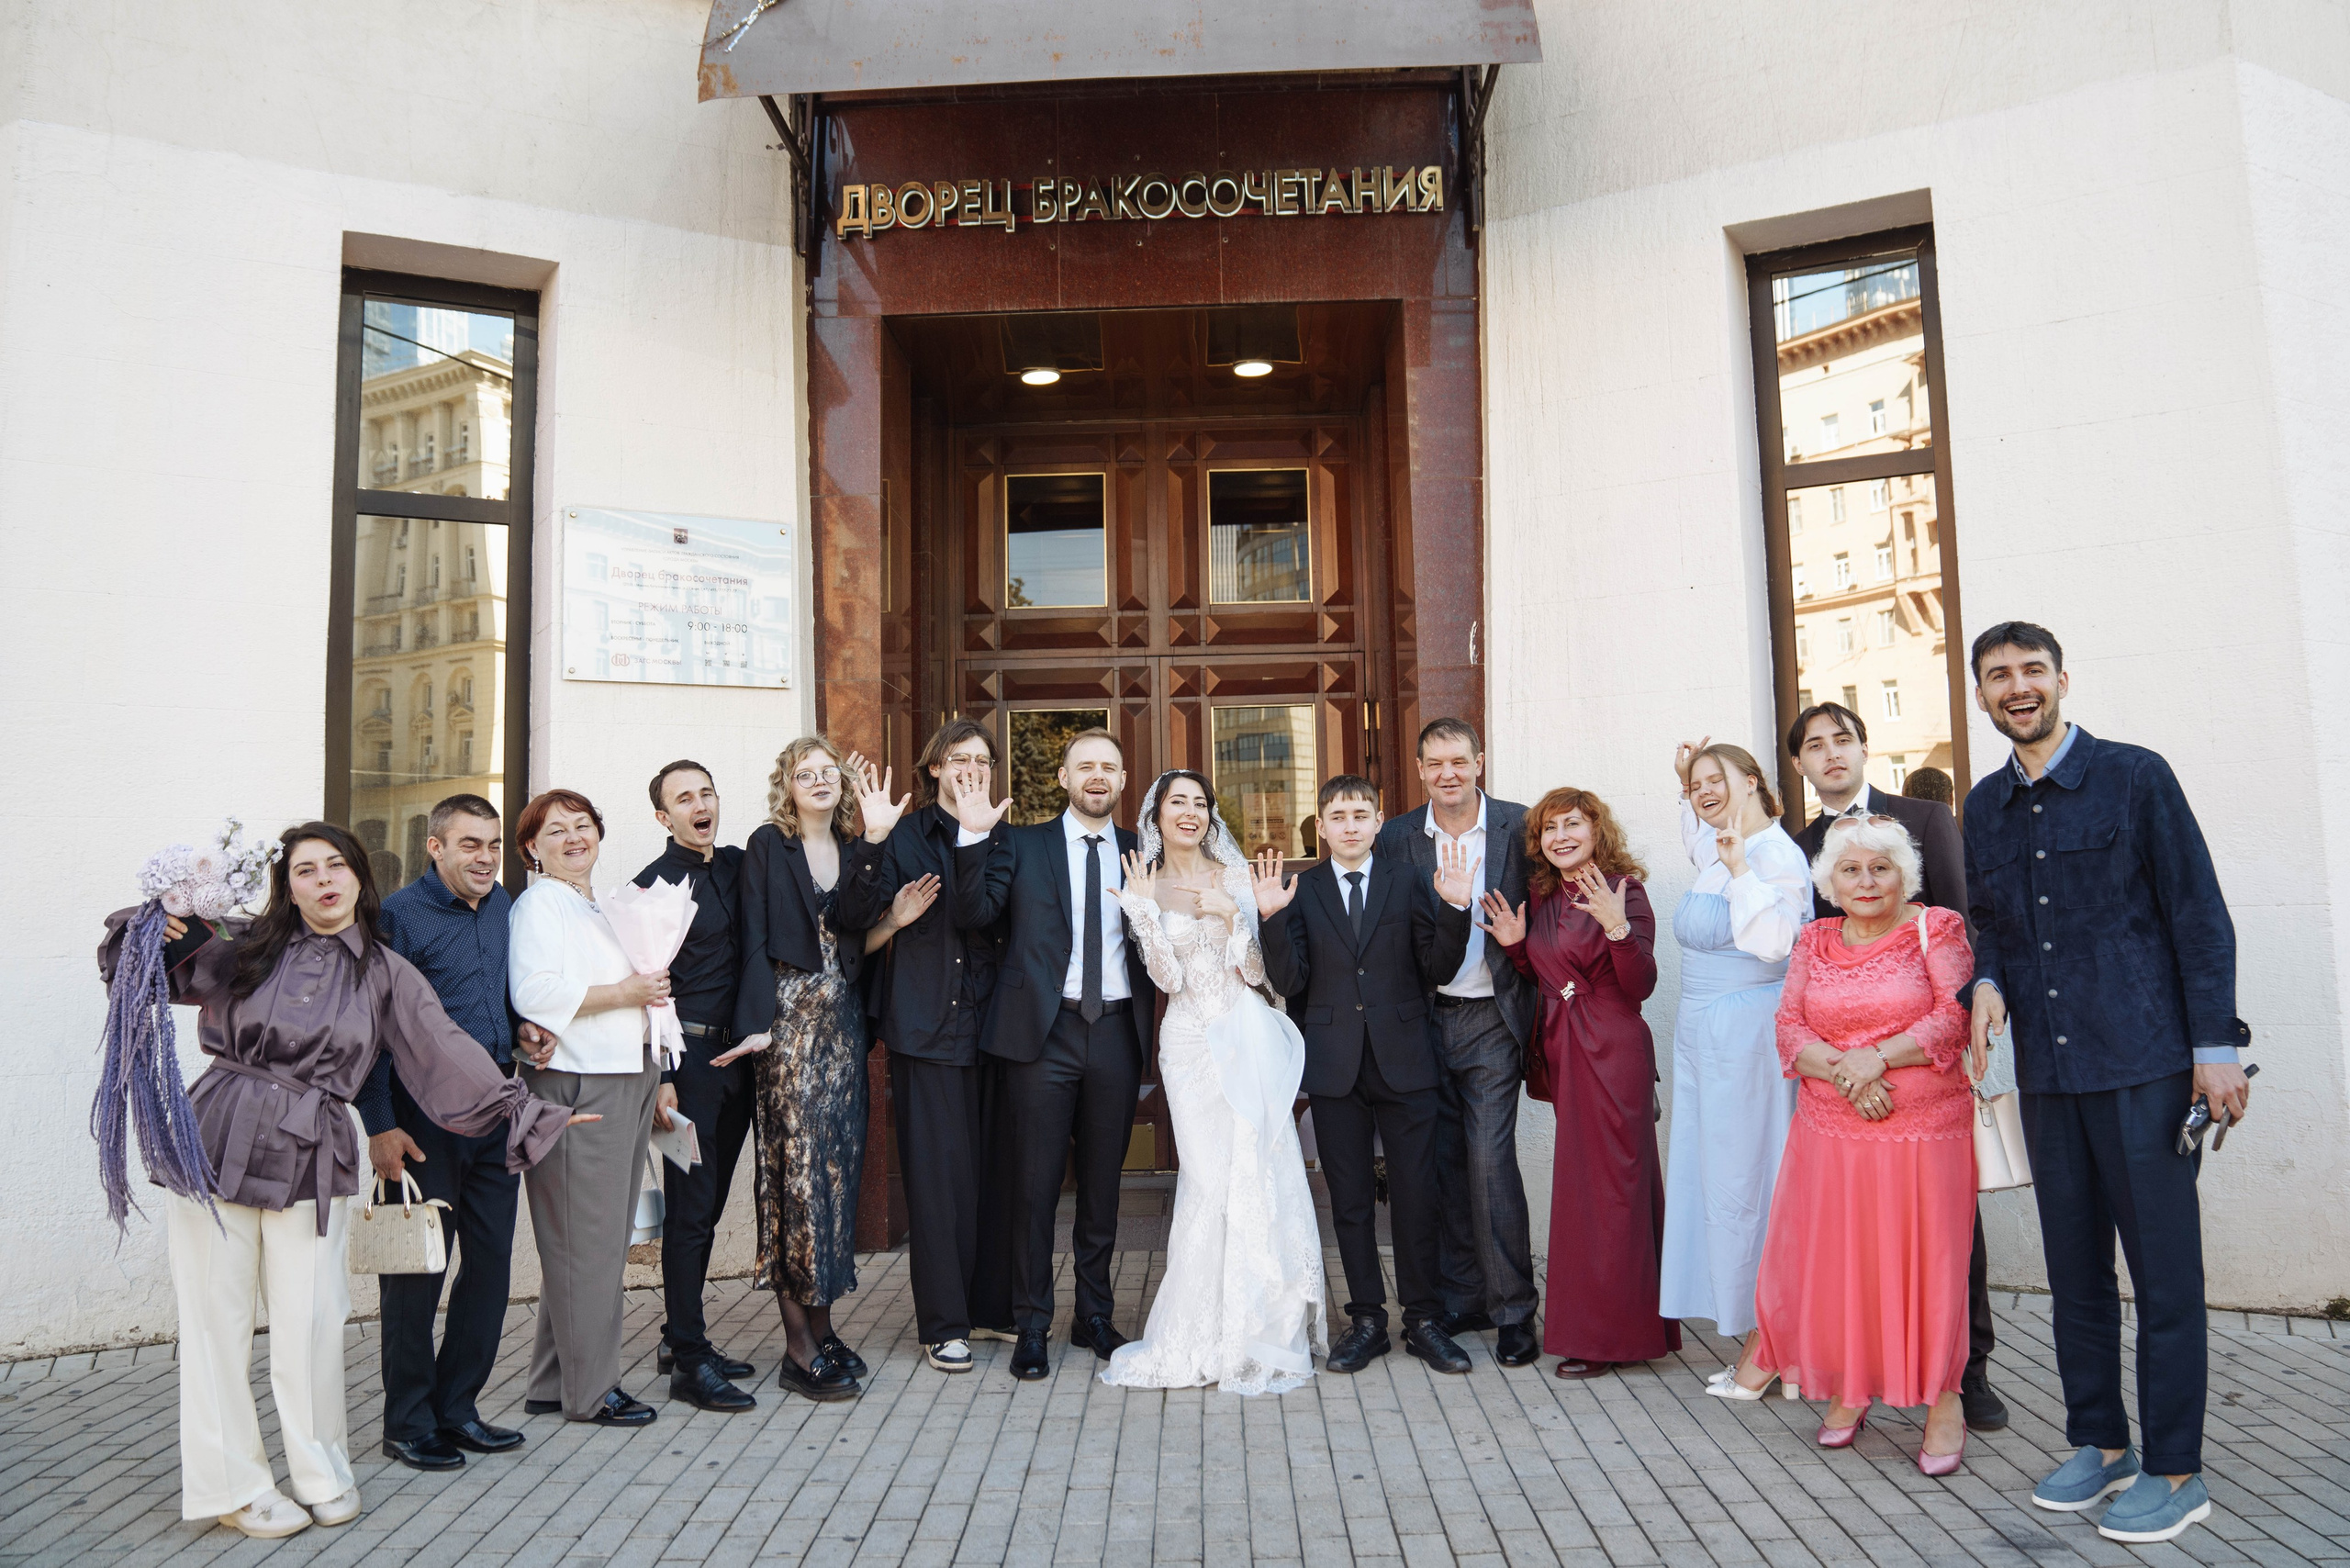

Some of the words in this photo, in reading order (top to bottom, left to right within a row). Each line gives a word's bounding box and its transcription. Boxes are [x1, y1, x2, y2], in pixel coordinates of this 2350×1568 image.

[836, 179, 1015, 241] ДВОРЕЦ
[1032, 165, 1444, 224] БРАКОСОЧЕТАНИЯ
[610, 566, 655, 581] Дворец
[657, 569, 748, 586] бракосочетания
[638, 601, 678, 613] РЕЖИМ
[681, 604, 722, 616] РАБОТЫ
[687, 621, 711, 632] 9:00
[721, 622, 748, 633] 18:00
